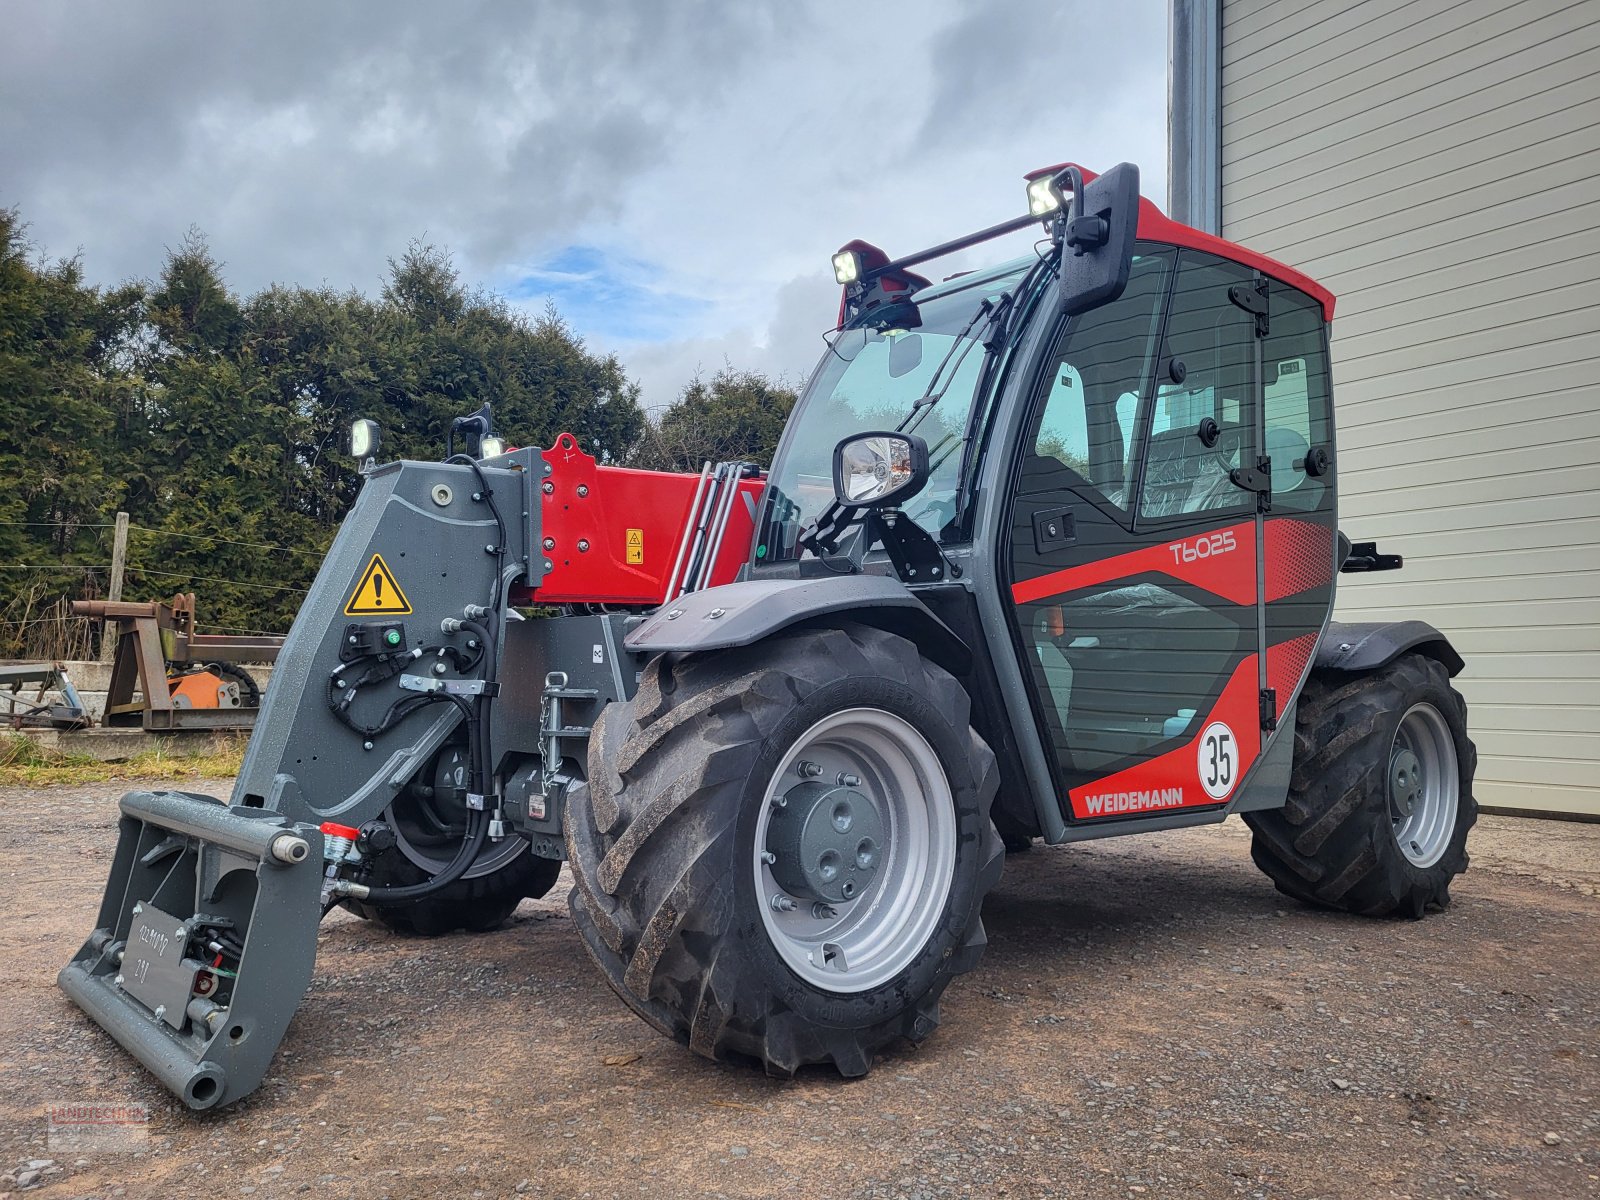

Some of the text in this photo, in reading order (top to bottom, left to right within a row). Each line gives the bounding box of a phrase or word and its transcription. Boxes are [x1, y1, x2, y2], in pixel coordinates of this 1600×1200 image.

[1169, 531, 1236, 565] T6025
[1207, 735, 1231, 787] 35
[1085, 788, 1183, 814] WEIDEMANN
